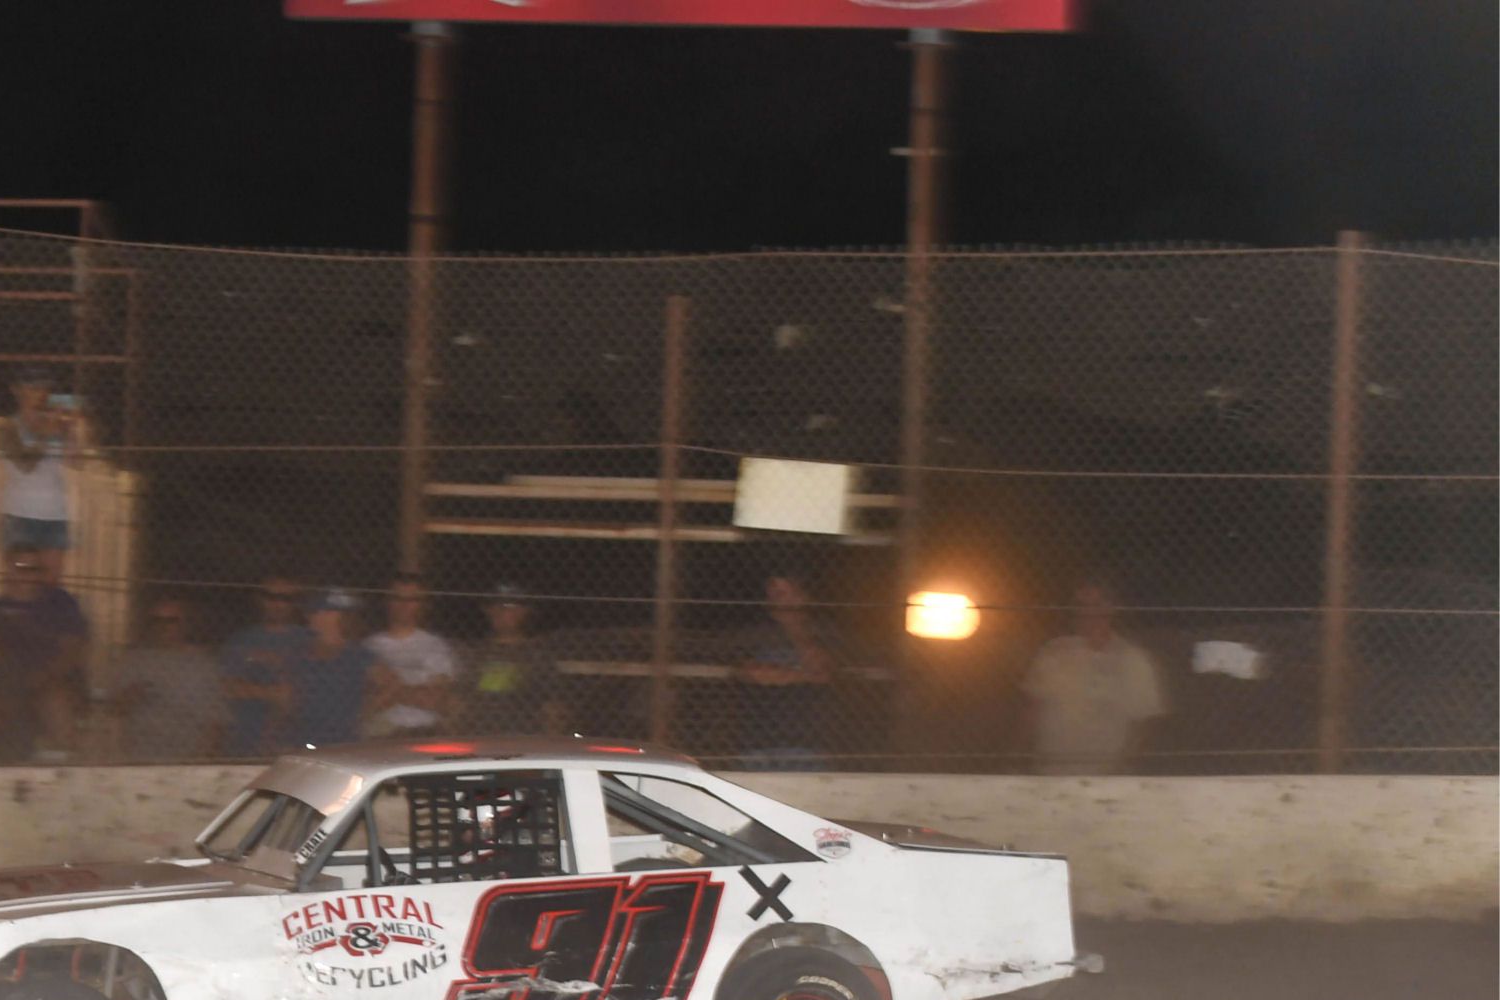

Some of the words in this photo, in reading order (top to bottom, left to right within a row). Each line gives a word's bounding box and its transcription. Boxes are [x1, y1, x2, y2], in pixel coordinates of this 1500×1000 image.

[282, 894, 444, 941] CENTRAL
[381, 921, 436, 941] METAL
[300, 944, 448, 989] ECYCLING
